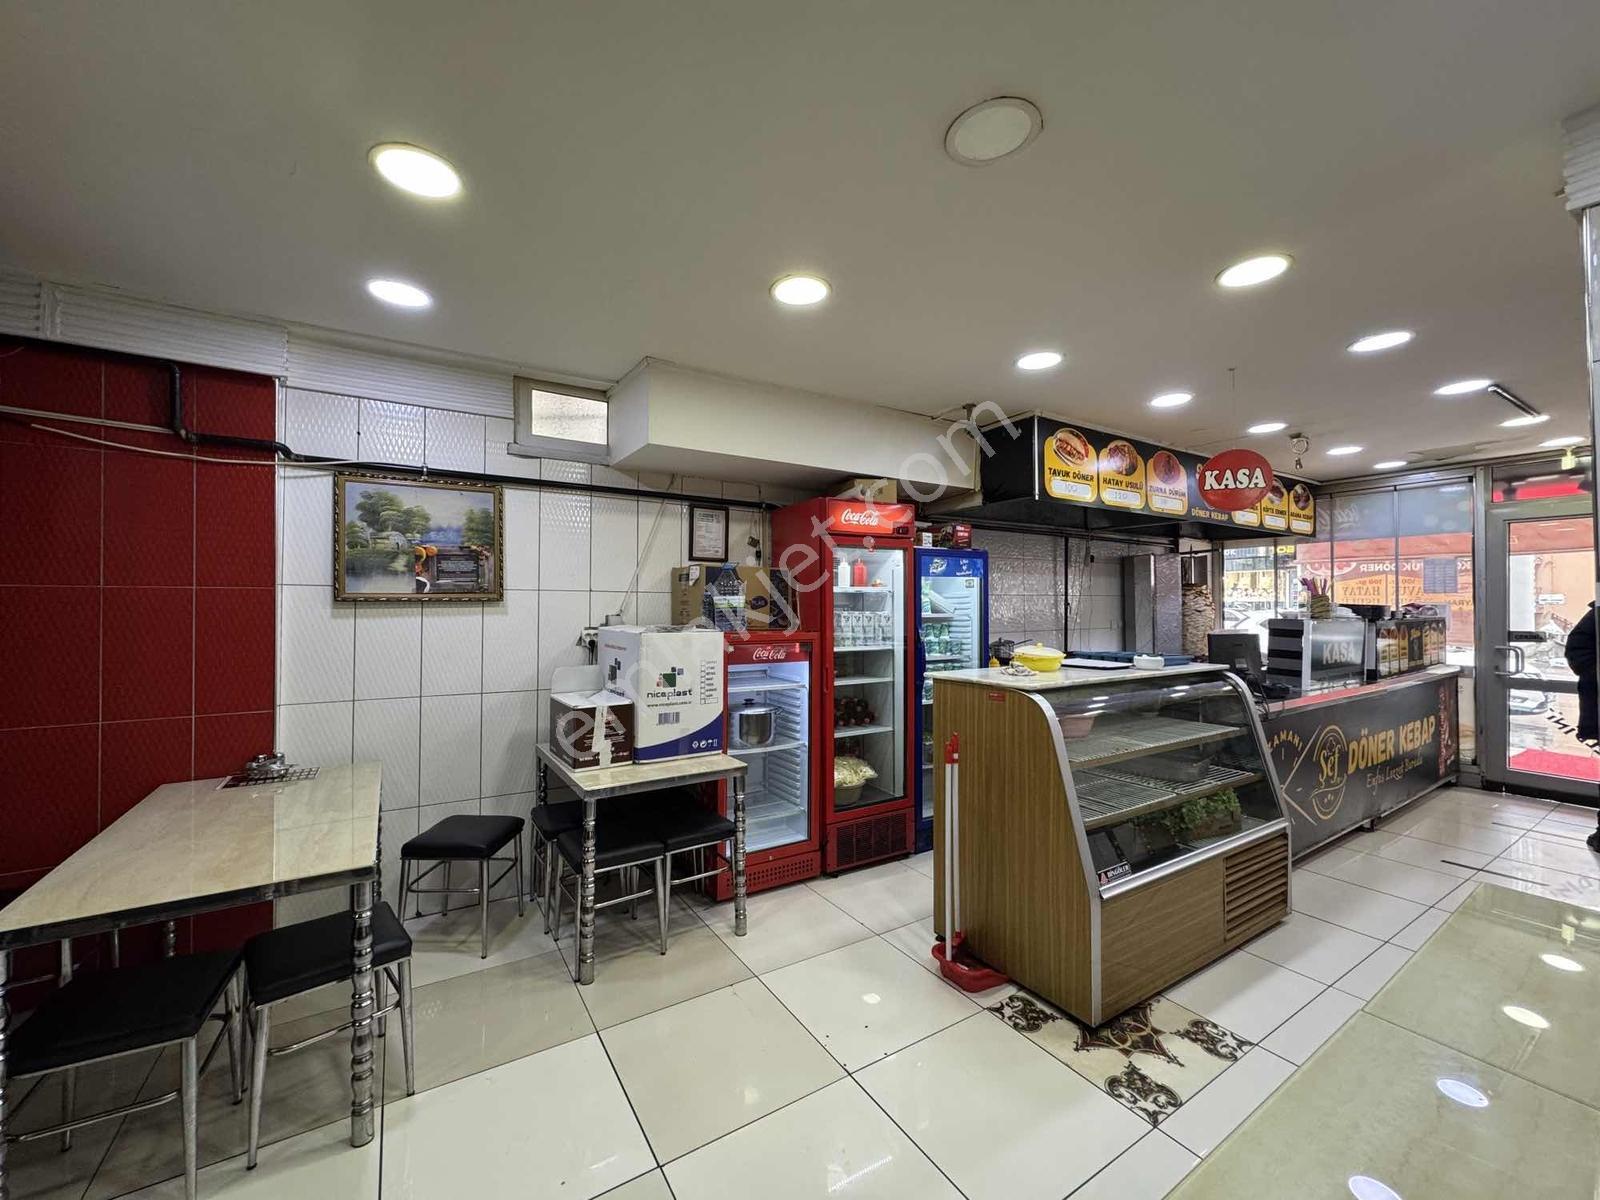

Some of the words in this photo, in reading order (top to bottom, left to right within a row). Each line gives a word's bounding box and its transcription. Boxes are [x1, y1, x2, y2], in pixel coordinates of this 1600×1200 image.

[1048, 467, 1070, 478] TAVUK
[1072, 470, 1094, 482] DÖNER
[1103, 476, 1123, 487] HATAY
[1204, 467, 1266, 490] KASA
[1191, 506, 1211, 518] DÖNER
[1211, 511, 1229, 521] KEBAP
[1322, 641, 1354, 665] KASA
[647, 688, 692, 700] niceplast
[1347, 728, 1395, 775] DÖNER
[1400, 715, 1436, 755] KEBAP
[1320, 744, 1342, 789] Şef
